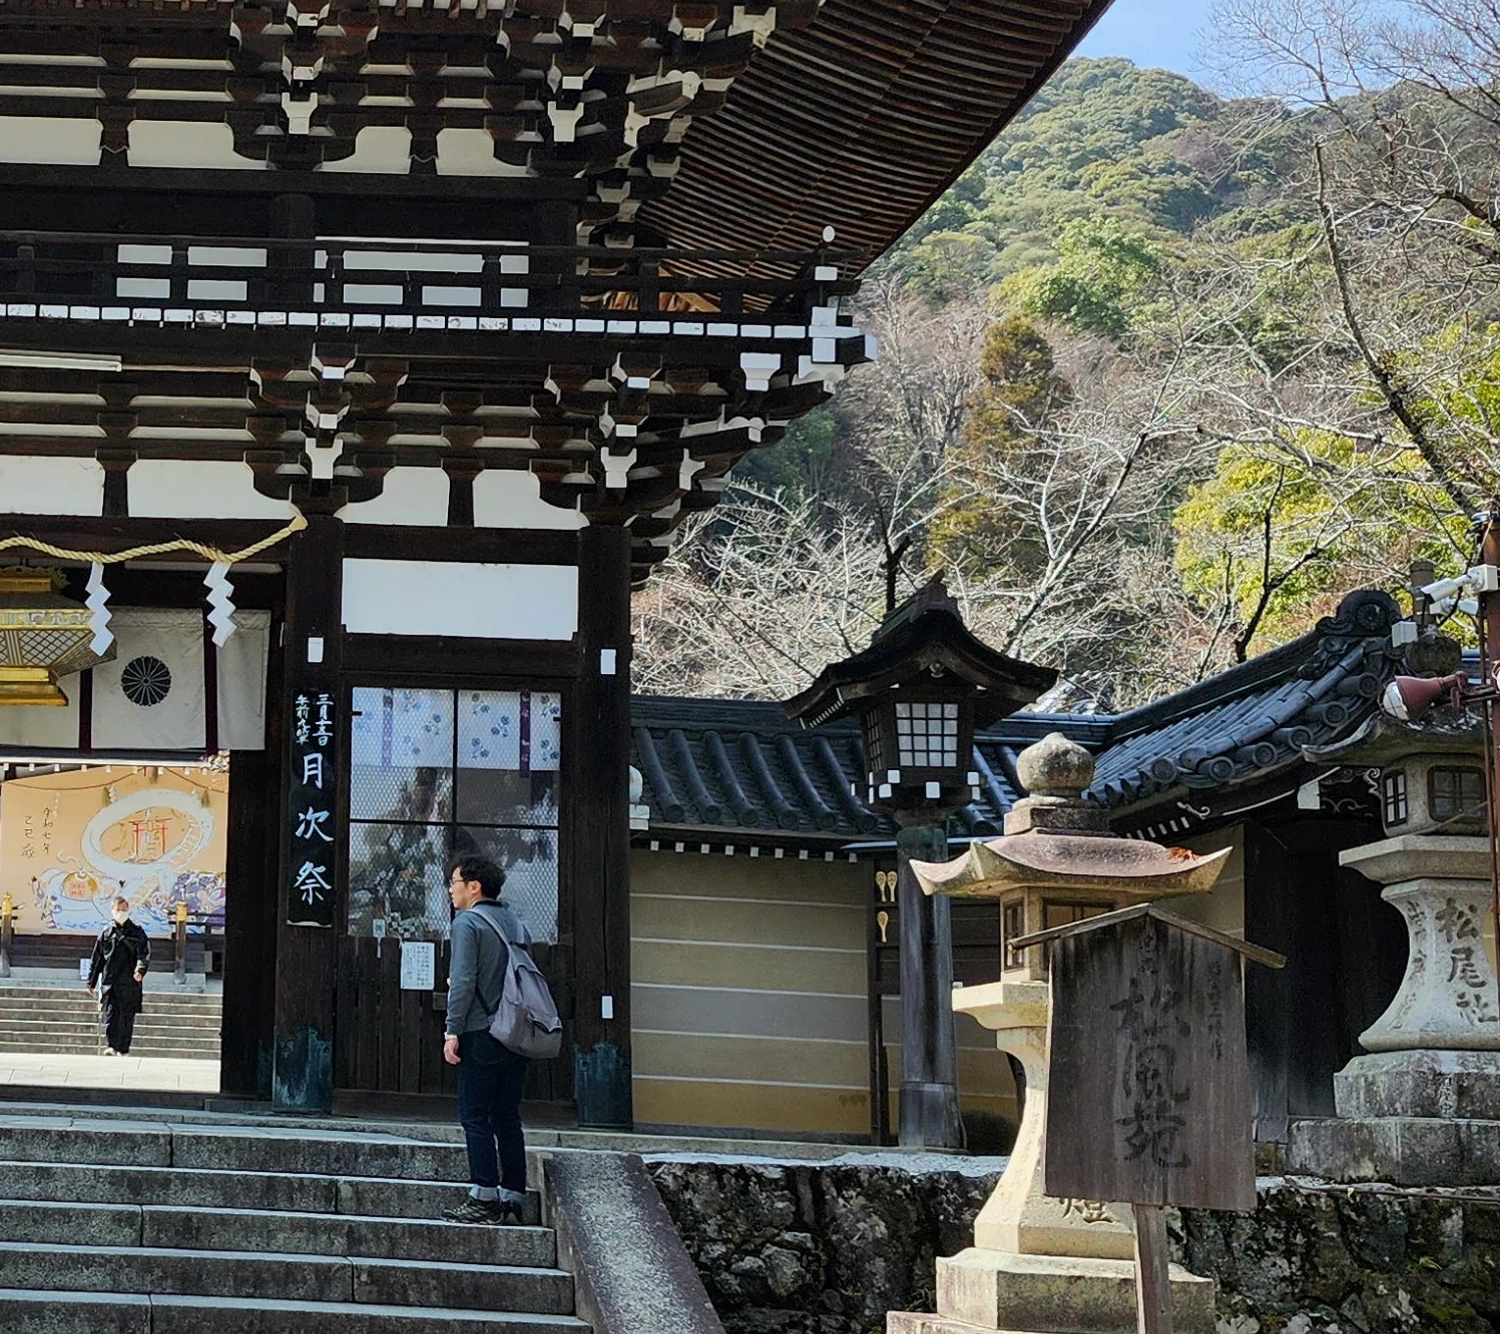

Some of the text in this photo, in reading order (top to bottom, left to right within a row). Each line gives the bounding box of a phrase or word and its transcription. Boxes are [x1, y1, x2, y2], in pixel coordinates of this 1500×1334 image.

[312, 693, 334, 746] 三月十五日
[294, 752, 335, 906] 月次祭
